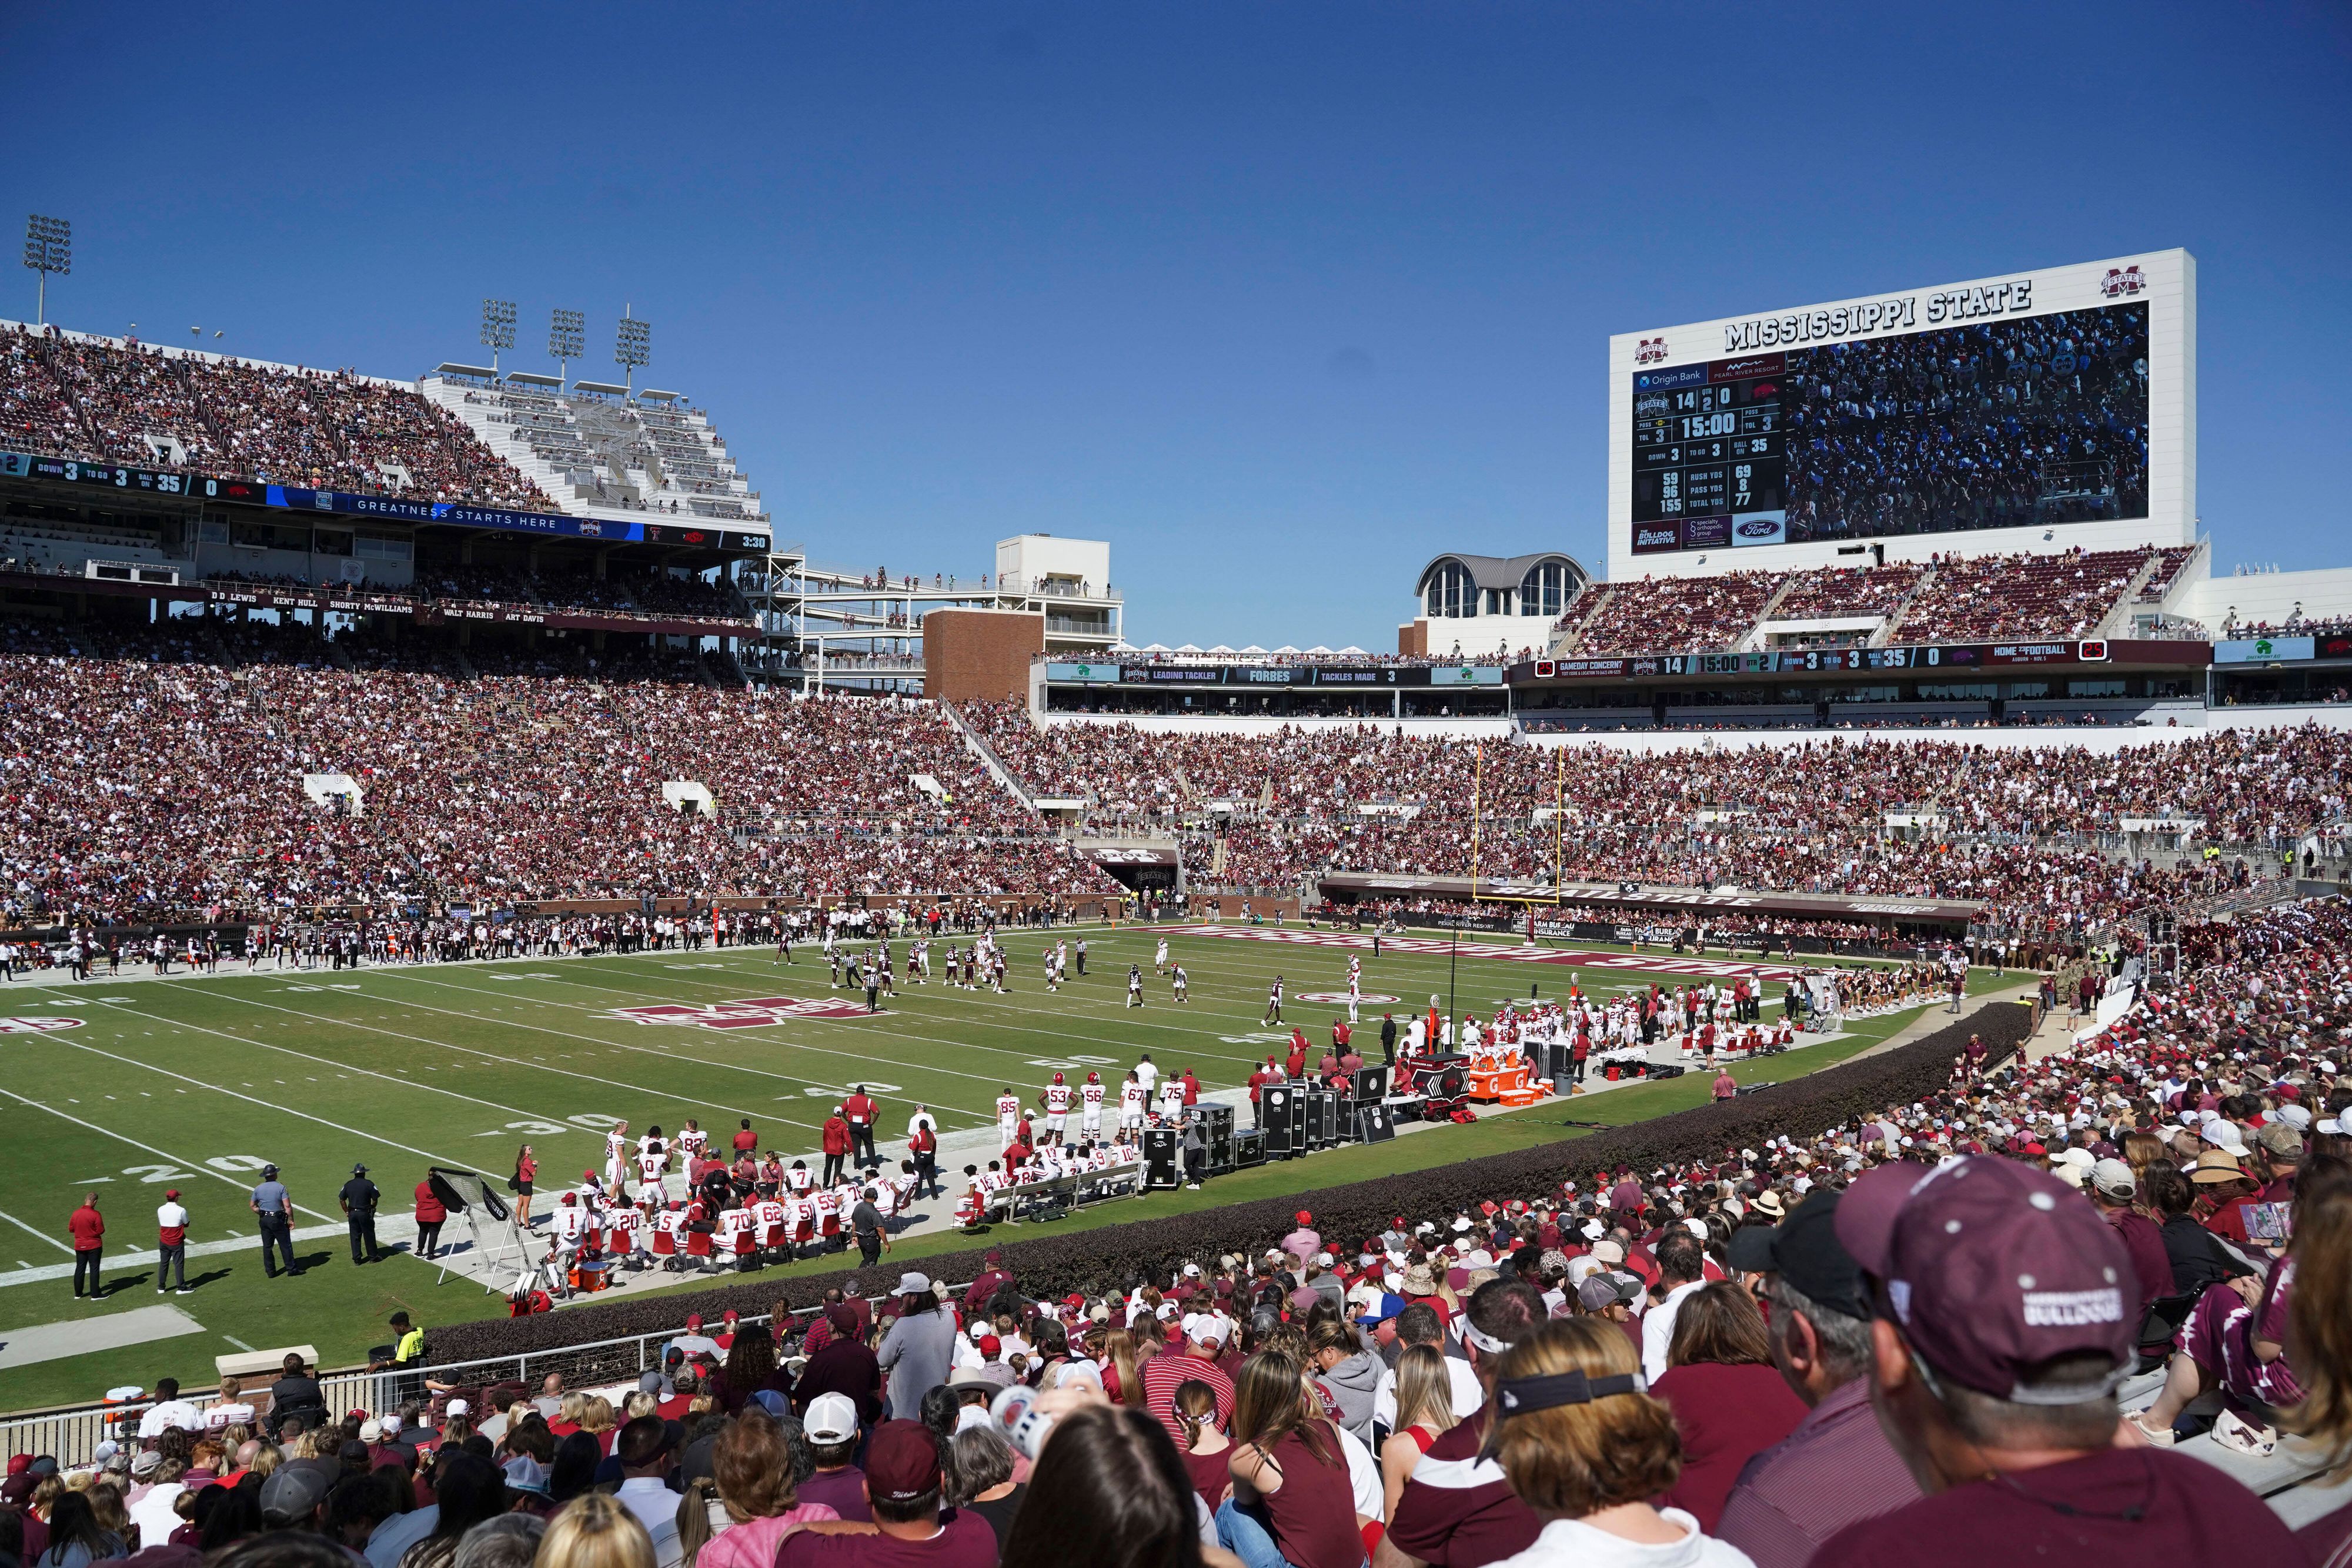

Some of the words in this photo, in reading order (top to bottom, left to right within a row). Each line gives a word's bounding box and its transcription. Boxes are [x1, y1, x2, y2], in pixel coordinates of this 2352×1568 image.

[2109, 272, 2137, 285] STATE
[1725, 297, 1916, 352] MISSISSIPPI
[1927, 280, 2032, 324] STATE
[1641, 345, 1662, 353] STATE
[1652, 375, 1678, 385] Origin
[1680, 372, 1700, 381] Bank
[1702, 388, 1712, 396] QTR
[1720, 388, 1730, 404] 0
[1676, 392, 1695, 410] 14
[1703, 397, 1712, 411] 2
[1682, 413, 1735, 439] 15:00
[1762, 416, 1772, 431] 3
[1656, 429, 1665, 443] 3
[1712, 443, 1720, 456] 3
[1751, 438, 1768, 453] 35
[1671, 448, 1679, 461] 3
[6, 455, 18, 473] 2
[38, 463, 63, 474] DOWN
[65, 462, 78, 480] 3
[86, 470, 95, 478] TO
[116, 470, 127, 486] 3
[1690, 472, 1708, 481] RUSH
[1709, 471, 1723, 479] YDS
[1735, 464, 1751, 479] 69
[158, 474, 179, 492] 35
[1663, 472, 1678, 486] 59
[1739, 479, 1748, 492] 8
[206, 480, 216, 496] 0
[1663, 485, 1678, 499] 96
[1690, 486, 1708, 494] PASS
[1710, 484, 1723, 493] YDS
[1660, 499, 1682, 513] 155
[1689, 499, 1708, 508] TOTAL
[1710, 498, 1723, 506] YDS
[1735, 492, 1751, 506] 77
[358, 500, 448, 518] GREATNESS
[456, 511, 512, 524] STARTS
[520, 517, 556, 529] HERE
[1639, 530, 1673, 540] BULLDOG
[1745, 522, 1772, 536] Ford
[743, 536, 766, 548] 3:30
[1637, 537, 1675, 546] INITIATIVE
[230, 593, 256, 603] LEWIS
[273, 597, 295, 606] KENT
[298, 599, 318, 607] HULL
[330, 601, 360, 610] SHORTY
[364, 604, 413, 613] McWILLIAMS
[444, 609, 463, 617] WALT
[466, 610, 494, 620] HARRIS
[506, 613, 520, 621] ART
[523, 615, 544, 623] DAVIS
[1994, 646, 2017, 656] HOME
[2025, 645, 2066, 655] FOOTBALL
[2084, 643, 2103, 656] 25
[1699, 656, 1740, 672] 15:00
[1759, 655, 1769, 671] 2
[1784, 657, 1804, 666] DOWN
[1806, 653, 1817, 669] 3
[1833, 656, 1842, 664] GO
[1849, 651, 1859, 668] 3
[1884, 650, 1905, 667] 35
[1928, 648, 1939, 666] 0
[1539, 663, 1552, 674] 25
[1560, 662, 1589, 670] GAMEDAY
[1590, 661, 1623, 669] CONCERN?
[1664, 657, 1682, 673] 14
[1153, 671, 1183, 680] LEADING
[1185, 671, 1216, 680] TACKLER
[1250, 670, 1290, 682] FORBES
[1321, 673, 1352, 681] TACKLES
[1355, 673, 1376, 681] MADE
[1388, 670, 1395, 682] 3
[1724, 992, 1730, 1001] 11
[1631, 1015, 1639, 1024] 52
[1024, 1055, 1119, 1069] 50
[1489, 1077, 1498, 1093] G
[1515, 1073, 1524, 1089] G
[1050, 1090, 1066, 1103] 53
[1086, 1090, 1101, 1102] 56
[1128, 1089, 1144, 1101] 67
[1167, 1088, 1181, 1099] 75
[1001, 1102, 1016, 1114] 85
[505, 1113, 628, 1135] 30
[684, 1138, 702, 1152] 82
[1096, 1152, 1105, 1165] 9
[1121, 1148, 1133, 1162] 10
[121, 1155, 275, 1183] 20
[645, 1159, 654, 1172] 0
[1088, 1162, 1094, 1172] 2
[797, 1172, 806, 1185] 7
[997, 1175, 1008, 1188] 14
[1022, 1171, 1034, 1184] 84
[817, 1195, 836, 1210] 55
[763, 1206, 781, 1222] 62
[799, 1205, 813, 1221] 51
[569, 1213, 575, 1229] 1
[620, 1214, 638, 1231] 20
[662, 1216, 673, 1231] 5
[730, 1215, 749, 1231] 70
